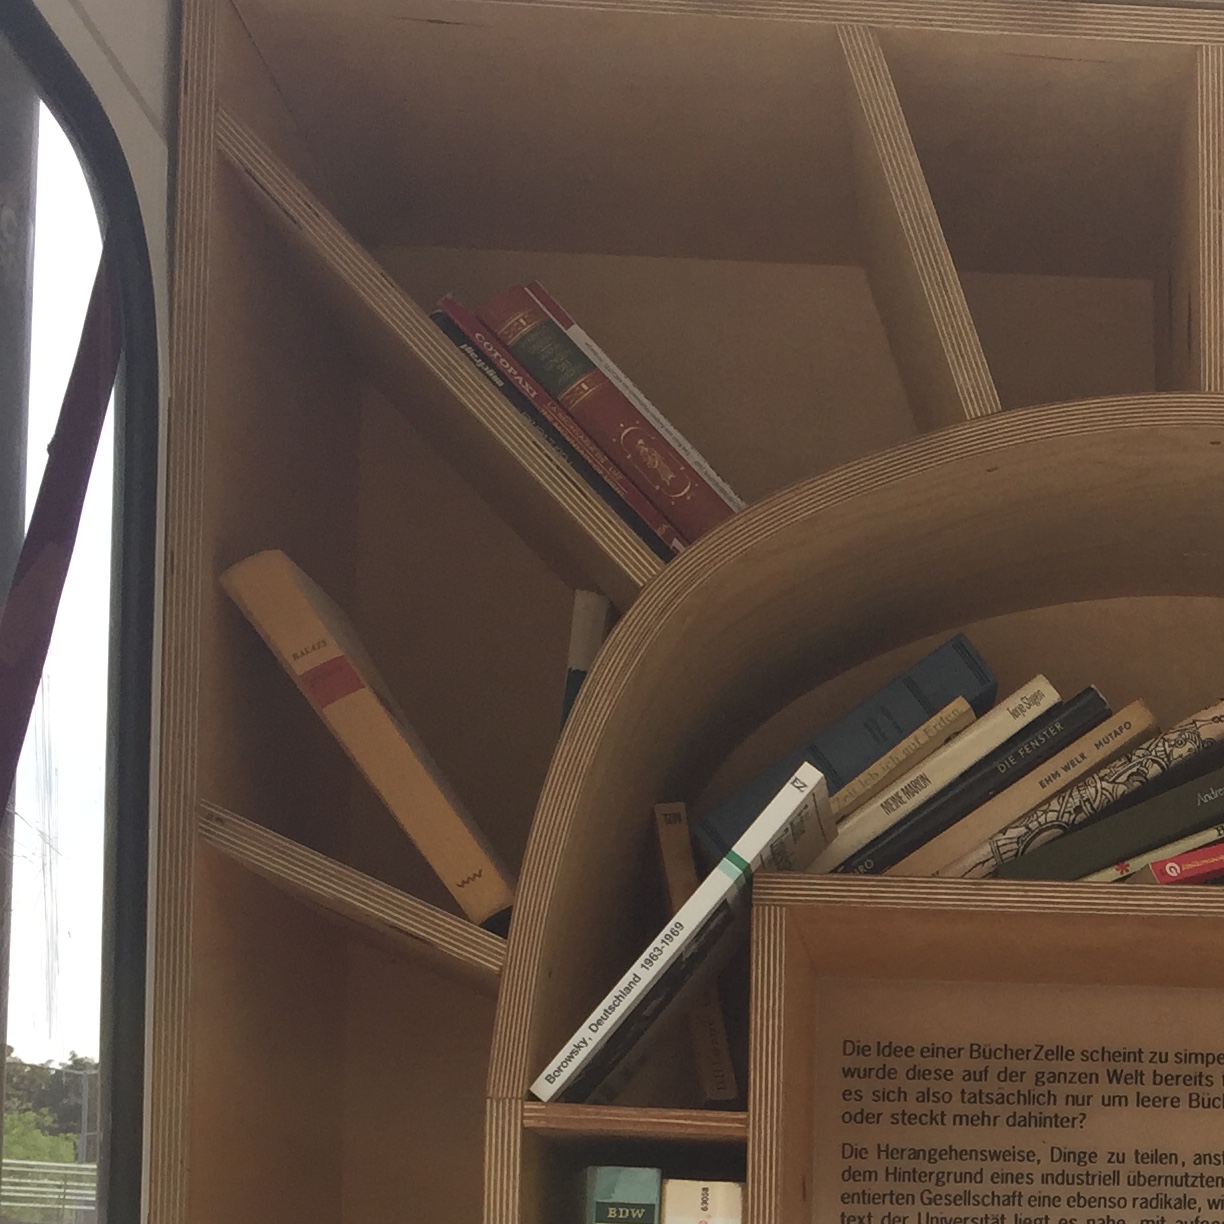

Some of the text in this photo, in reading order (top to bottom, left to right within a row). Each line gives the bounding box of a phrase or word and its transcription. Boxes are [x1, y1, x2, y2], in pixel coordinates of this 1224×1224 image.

[473, 330, 539, 398] COTOPAXI
[996, 720, 1065, 774] DIE FENSTER
[1037, 750, 1087, 789] EHM WELK
[878, 789, 906, 816] MEINE
[543, 919, 685, 1086] Borowsky, Deutschland 1963-1969
[842, 1039, 872, 1059] Die
[876, 1040, 916, 1060] Idee
[919, 1040, 966, 1060] einer
[1079, 1044, 1145, 1064] scheint
[1147, 1049, 1170, 1065] zu
[841, 1062, 899, 1082] wurde
[904, 1063, 955, 1083] diese
[961, 1064, 990, 1084] auf
[996, 1065, 1027, 1085] der
[1033, 1070, 1100, 1090] ganzen
[1105, 1067, 1146, 1087] Welt
[1151, 1068, 1215, 1088] bereits
[841, 1088, 864, 1104] es
[871, 1085, 908, 1105] sich
[914, 1086, 954, 1106] also
[1064, 1092, 1094, 1108] nur
[1100, 1093, 1130, 1109] um
[1135, 1090, 1182, 1110] leere
[840, 1107, 1088, 1130] oder steckt mehr dahinter?
[840, 1165, 879, 1185] dem
[884, 1166, 984, 1190] Hintergrund
[989, 1167, 1035, 1187] eines
[1040, 1168, 1121, 1188] industriell
[607, 1207, 645, 1219] BDW
